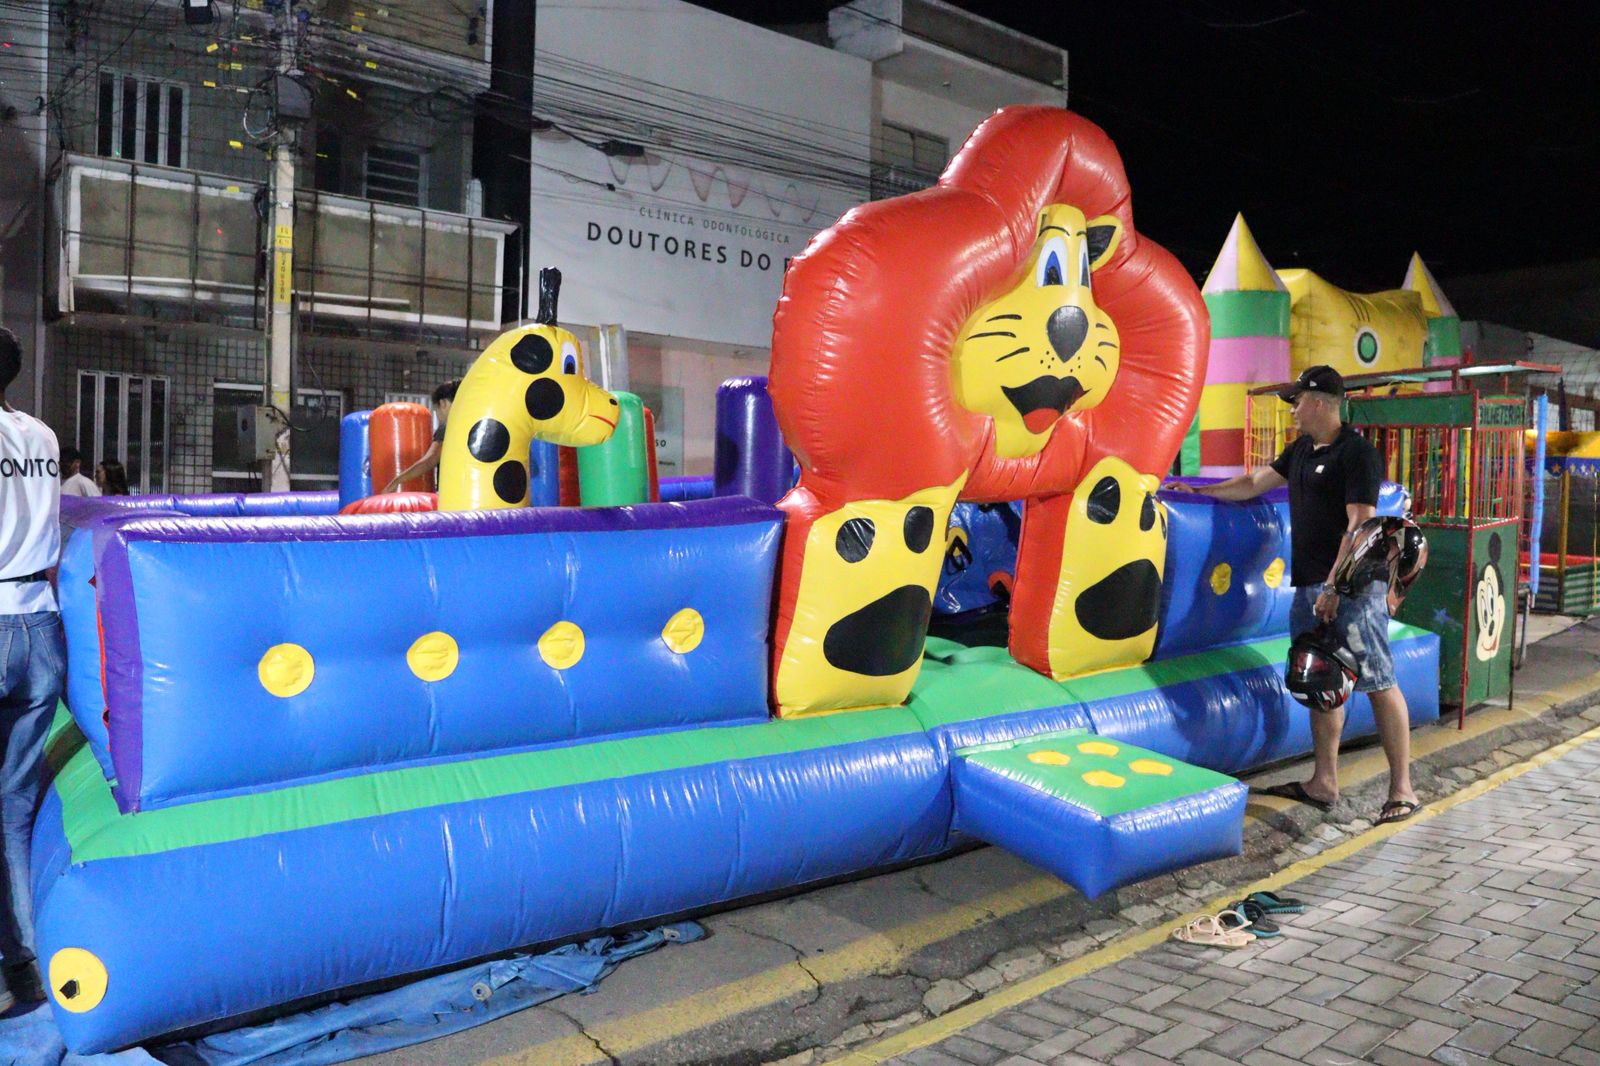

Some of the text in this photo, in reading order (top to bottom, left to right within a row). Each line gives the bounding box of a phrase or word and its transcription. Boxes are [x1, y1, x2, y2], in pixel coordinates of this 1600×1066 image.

[639, 206, 695, 226] CLÍNICA
[587, 221, 727, 264] DOUTORES
[740, 250, 771, 271] DO
